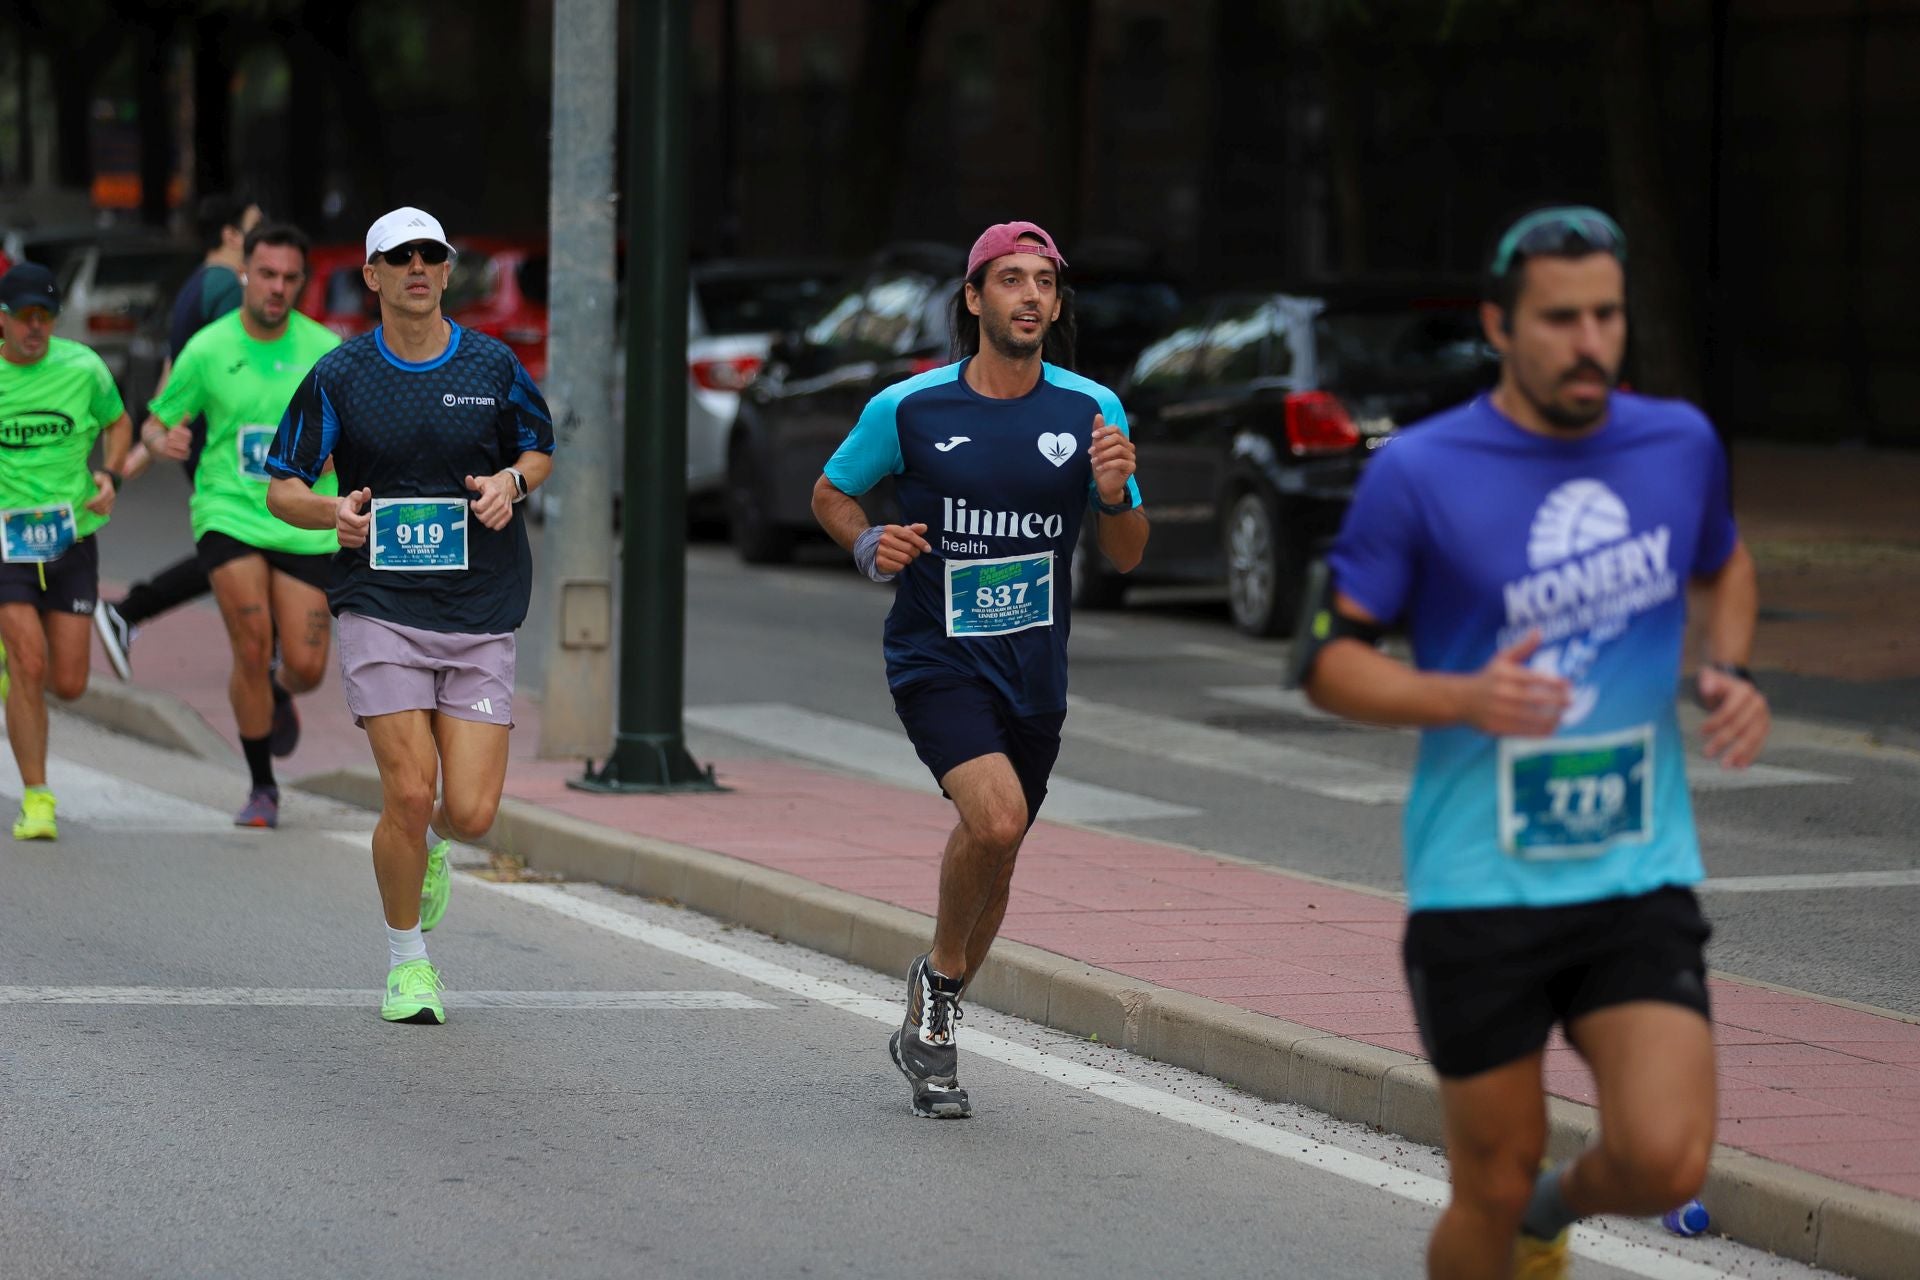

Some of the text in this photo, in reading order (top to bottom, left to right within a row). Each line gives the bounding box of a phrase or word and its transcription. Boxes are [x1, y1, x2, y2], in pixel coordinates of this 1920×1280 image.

[457, 396, 475, 405] NTT
[943, 497, 1063, 538] linneo
[396, 523, 444, 545] 919
[942, 536, 988, 555] health
[1503, 525, 1671, 627] KONERY
[976, 582, 1029, 608] 837
[999, 609, 1020, 617] HEALTH
[1544, 773, 1627, 818] 779
